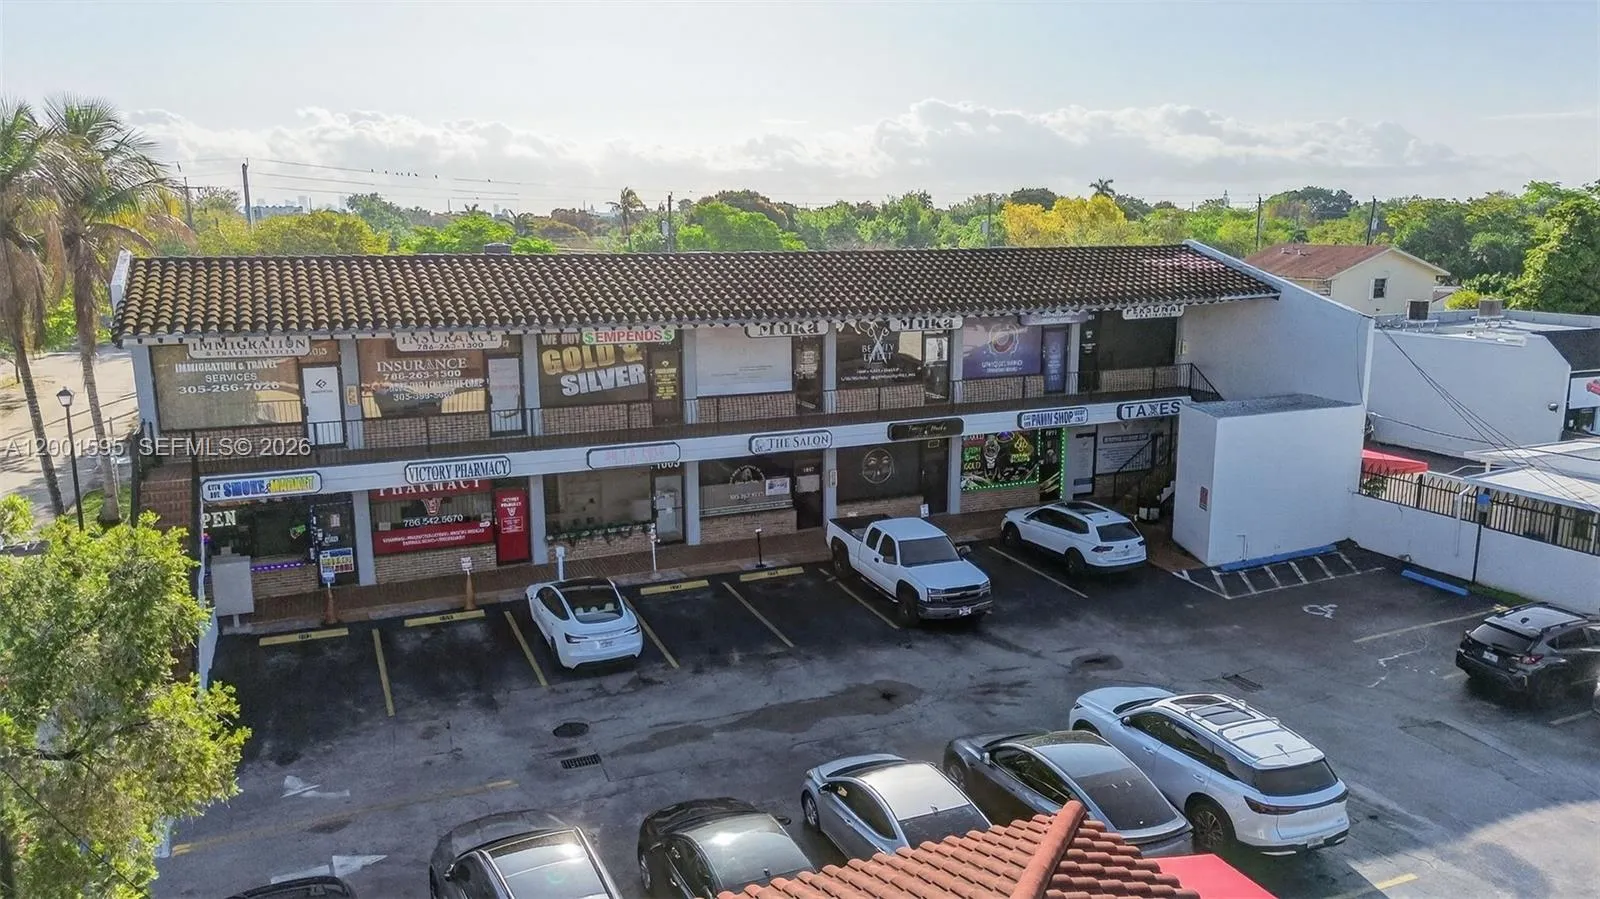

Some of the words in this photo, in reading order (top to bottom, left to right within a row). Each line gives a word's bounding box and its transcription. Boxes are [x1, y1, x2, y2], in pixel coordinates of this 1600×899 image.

[192, 338, 307, 351] IMMIGRATION
[402, 333, 498, 345] INSURANCE
[541, 333, 558, 345] WE
[561, 331, 580, 345] BUY
[175, 361, 237, 373] IMMIGRATION
[246, 359, 279, 370] TRAVEL
[376, 357, 468, 373] INSURANCE
[541, 344, 616, 376] GOLD
[205, 372, 258, 383] SERVICES
[560, 363, 647, 397] SILVER
[178, 381, 280, 395] 305-266-7026
[1125, 401, 1181, 418] TAXES
[1054, 411, 1074, 425] SHOP
[769, 438, 790, 449] THE
[793, 434, 829, 449] SALON
[409, 464, 451, 483] VICTORY
[455, 460, 508, 479] PHARMACY
[223, 480, 265, 498] SMOKE
